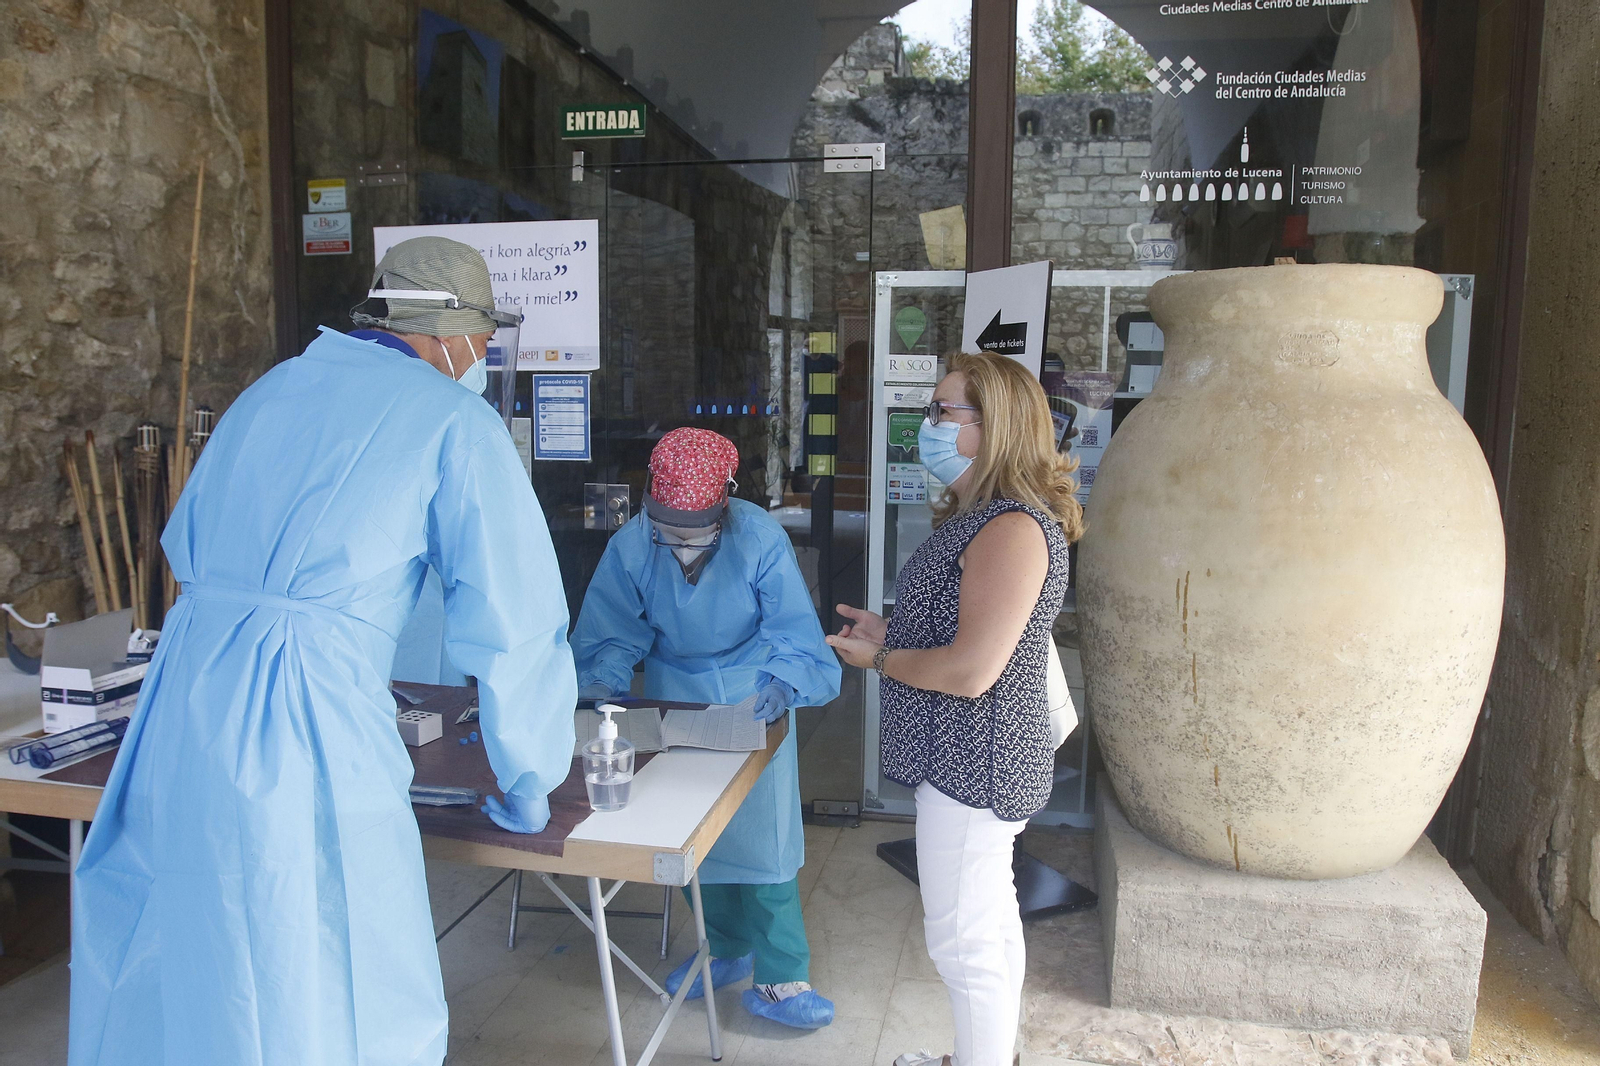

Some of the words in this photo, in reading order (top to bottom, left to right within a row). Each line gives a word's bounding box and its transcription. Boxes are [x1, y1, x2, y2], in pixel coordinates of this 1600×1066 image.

[1159, 3, 1210, 16] Ciudades
[1212, 0, 1252, 12] Medias
[1255, 0, 1293, 9] Centro
[1216, 72, 1272, 85] Fundación
[1274, 70, 1324, 84] Ciudades
[1326, 69, 1366, 82] Medias
[1215, 86, 1234, 99] del
[1235, 87, 1273, 99] Centro
[1274, 86, 1288, 98] de
[1290, 84, 1346, 98] Andalucía
[566, 109, 640, 131] ENTRADA
[1140, 169, 1222, 179] Ayuntamiento
[1224, 168, 1239, 178] de
[1242, 168, 1283, 178] Lucena
[1302, 167, 1362, 176] PATRIMONIO
[1301, 182, 1346, 190] TURISMO
[1300, 196, 1343, 204] CULTURA
[498, 244, 522, 258] kon
[984, 341, 998, 349] venta
[999, 339, 1006, 348] de
[1007, 338, 1024, 348] tickets
[889, 359, 932, 371] RASGO
